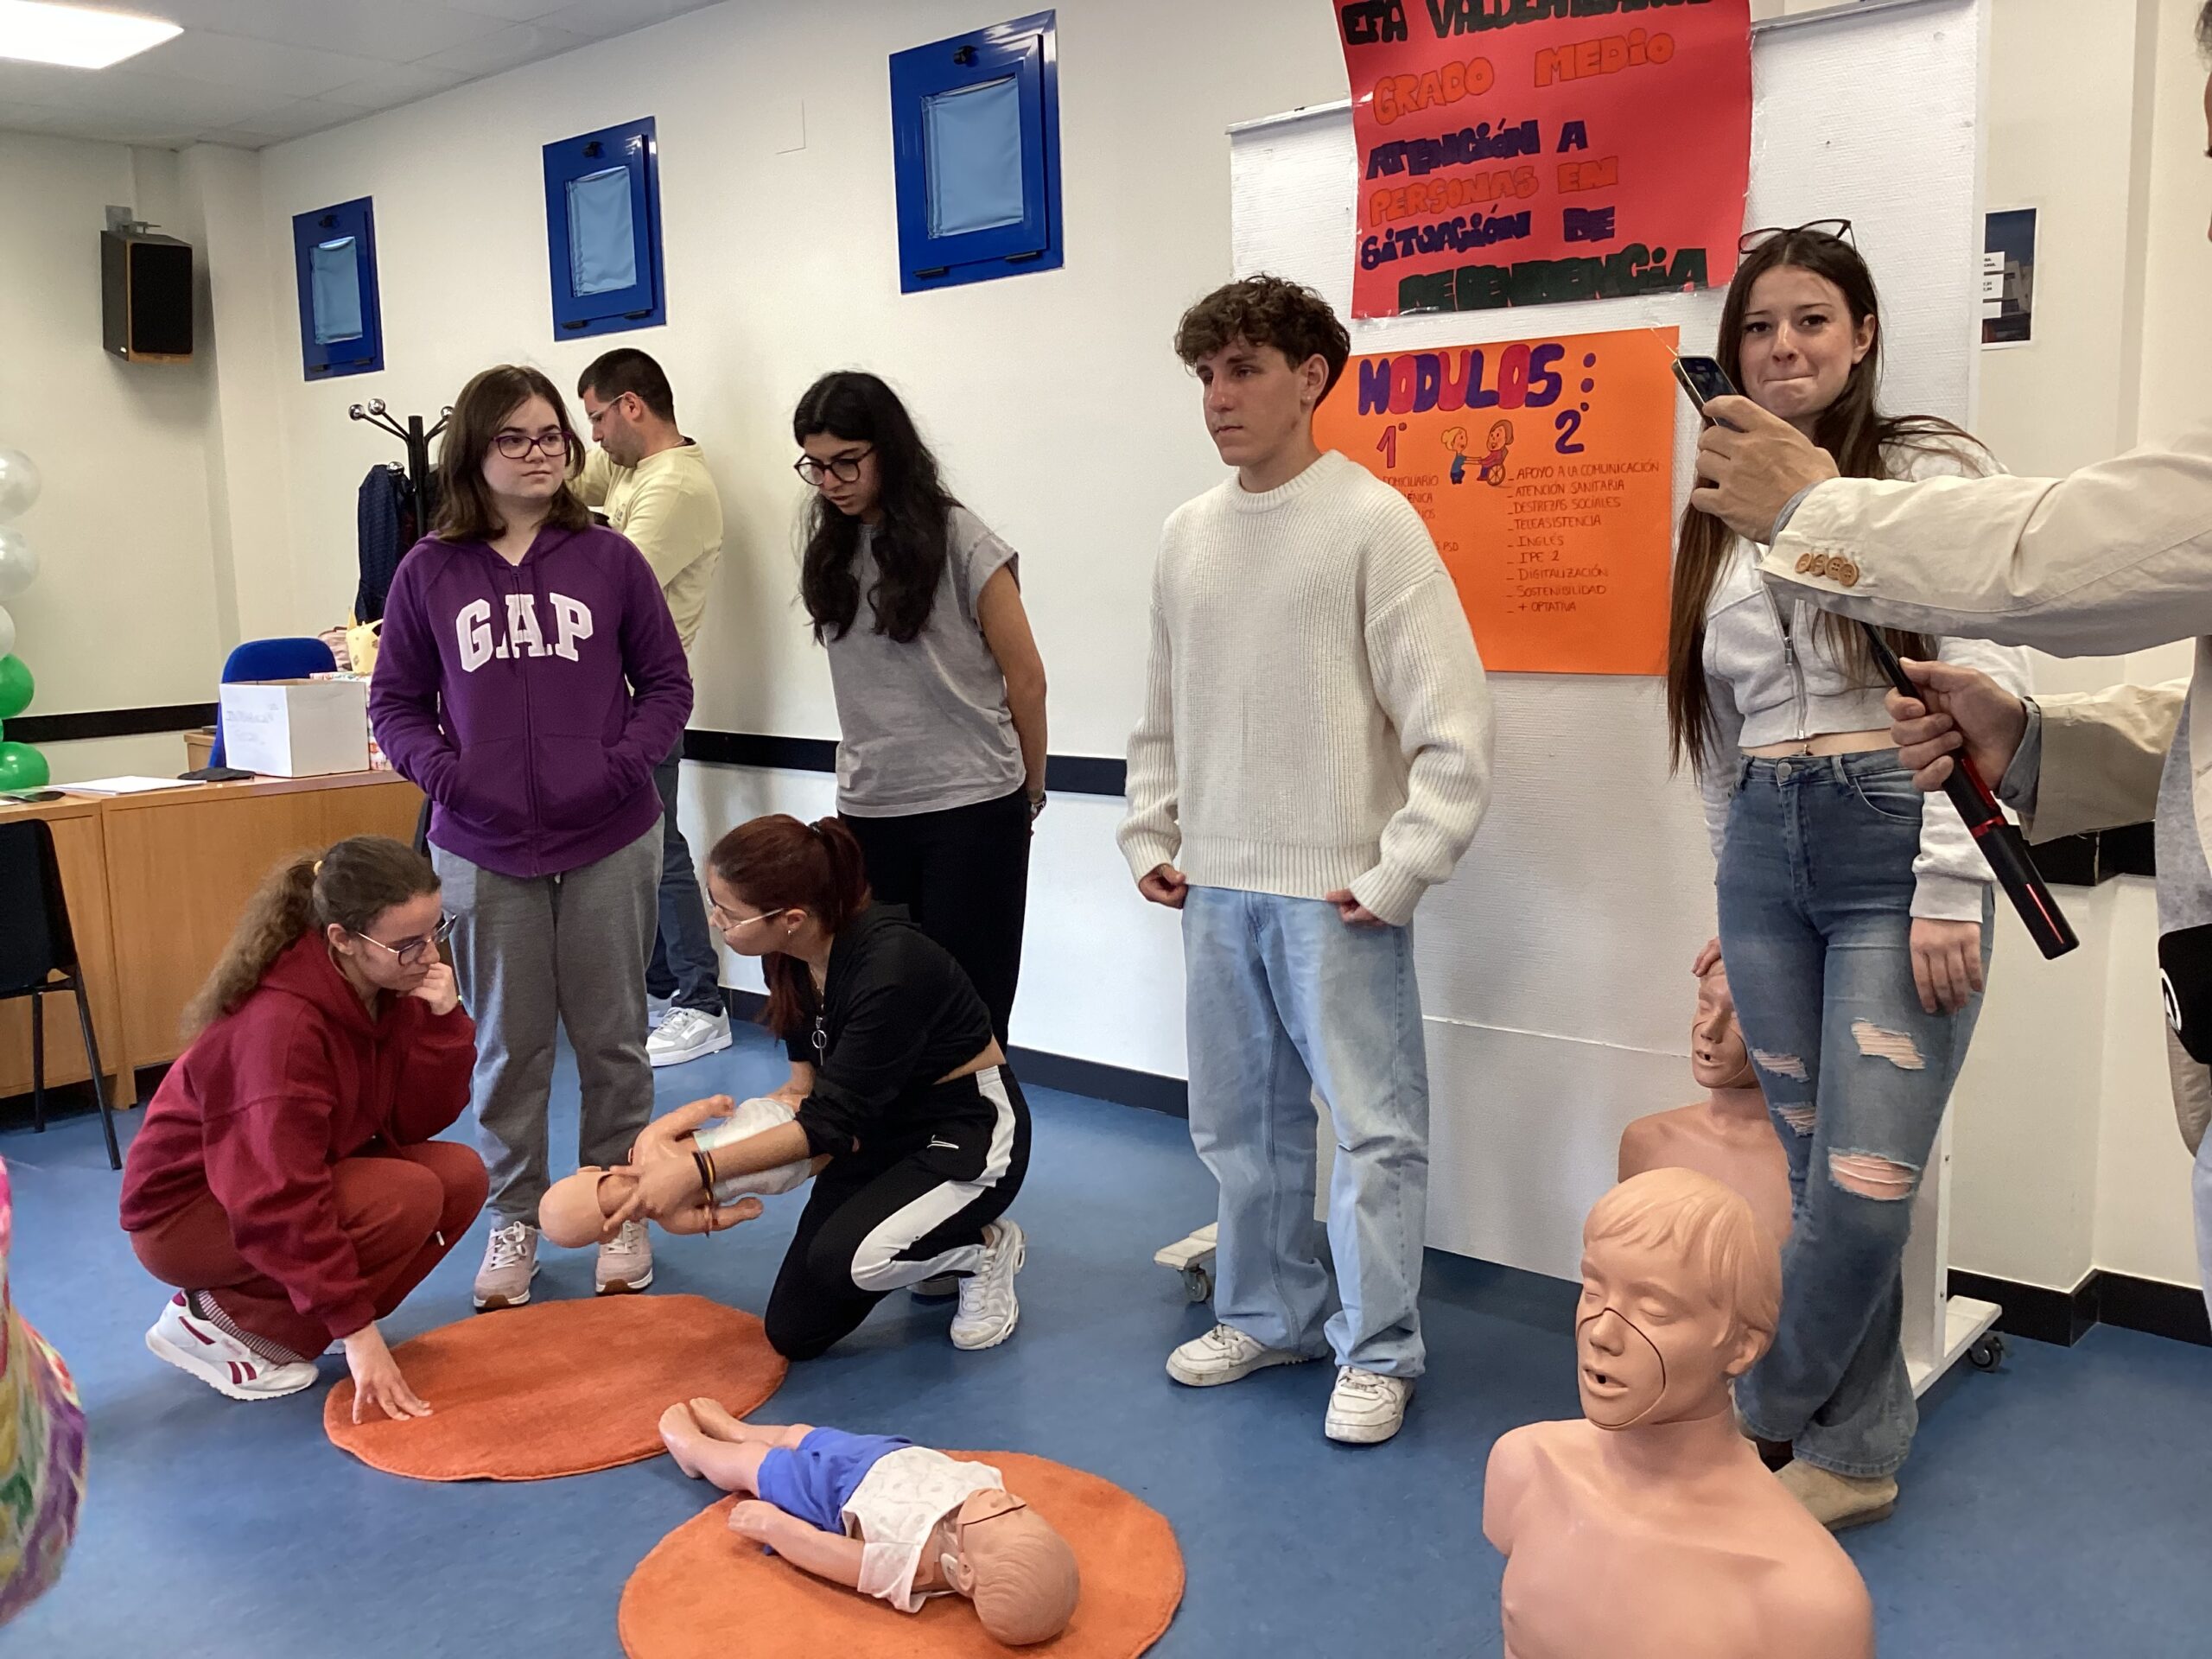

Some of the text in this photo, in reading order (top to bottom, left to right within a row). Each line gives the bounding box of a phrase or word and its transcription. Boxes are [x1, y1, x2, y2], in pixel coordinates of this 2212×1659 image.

[1373, 57, 1495, 125] GRADO
[1556, 120, 1589, 153] A
[1370, 156, 1619, 227] PERSONAS EN
[1563, 207, 1616, 243] DE
[1516, 465, 1554, 480] APOYO
[1557, 465, 1566, 478] A
[1514, 499, 1568, 514] DESTREZAS
[1442, 541, 1459, 552] PSD
[1520, 550, 1560, 564] IPE 2
[1531, 601, 1577, 613] OPTATIVA
[455, 592, 594, 673] GAP
